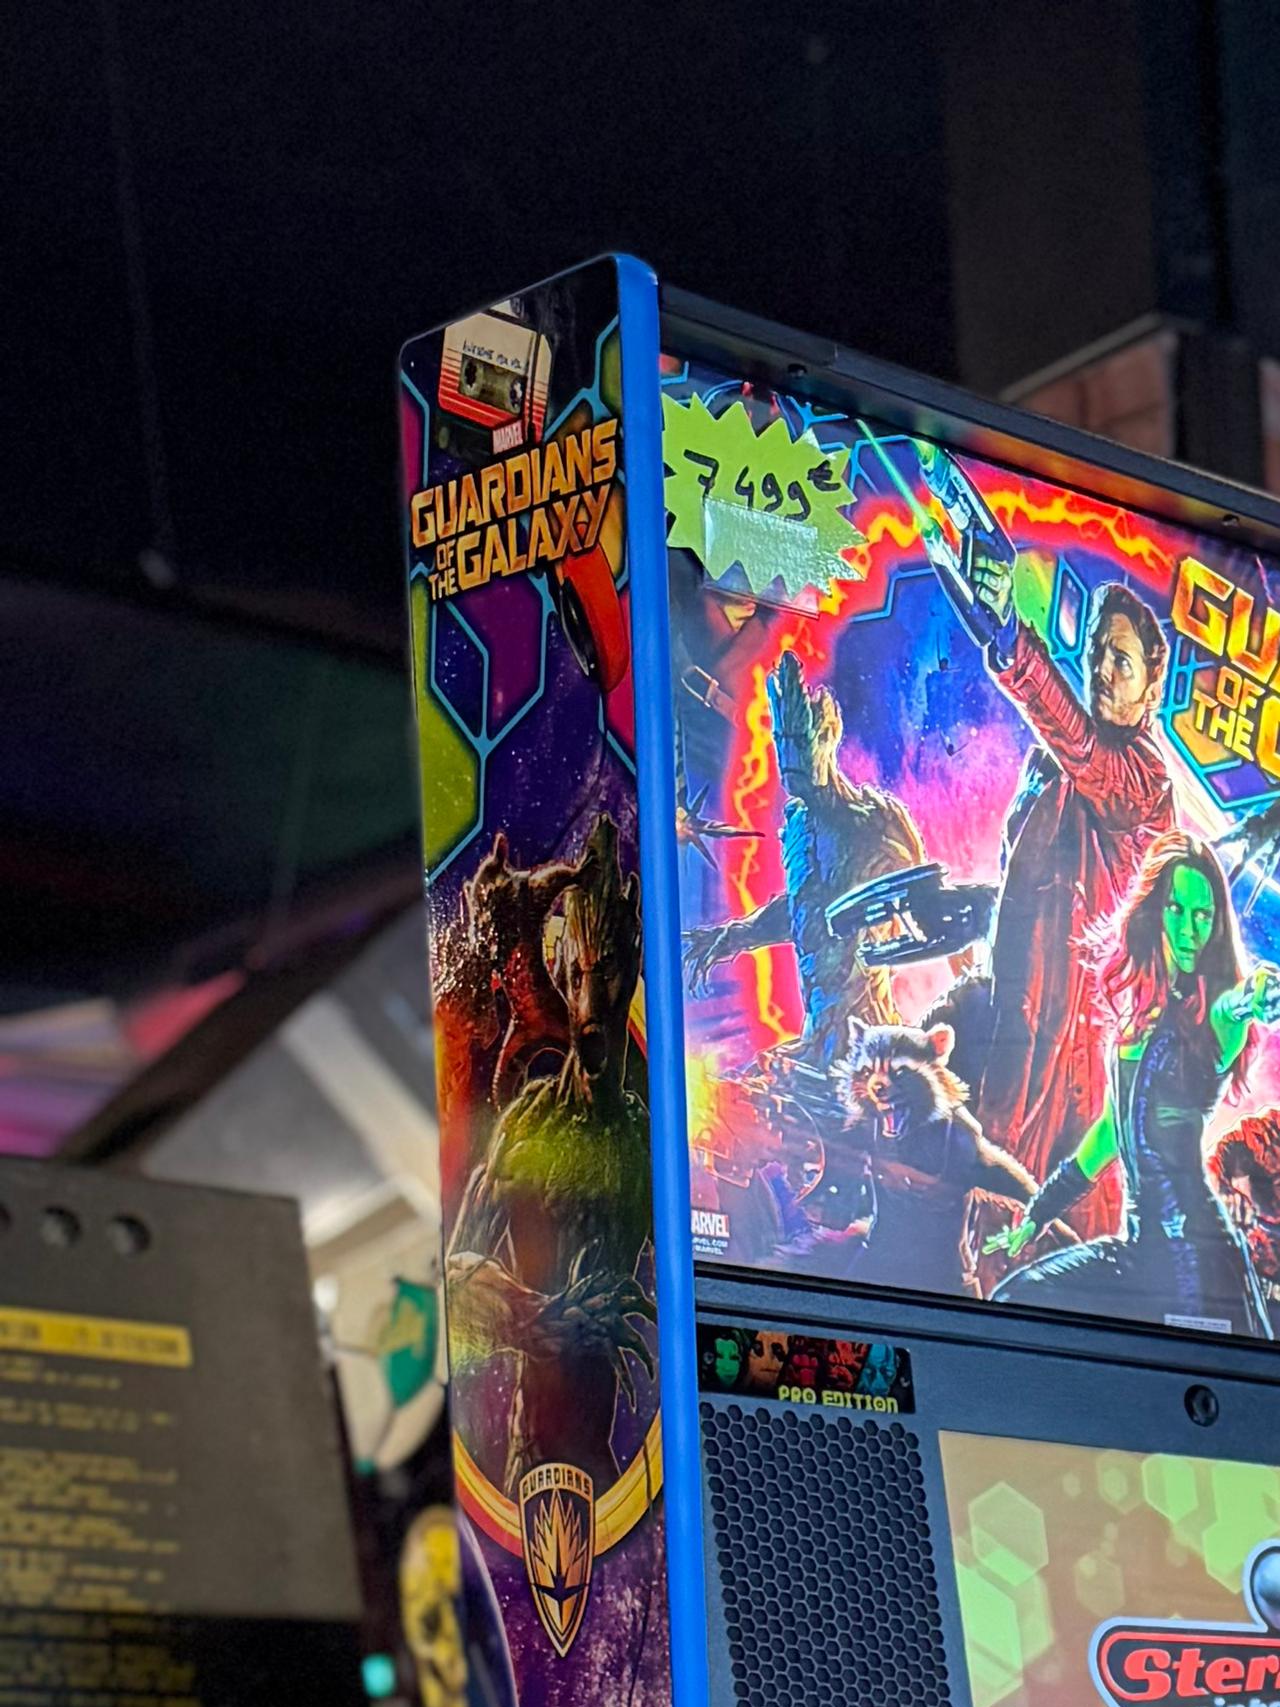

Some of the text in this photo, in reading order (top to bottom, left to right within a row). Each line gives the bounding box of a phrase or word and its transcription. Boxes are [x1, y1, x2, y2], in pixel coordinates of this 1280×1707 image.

[411, 419, 618, 548] GUARDIANS
[428, 484, 611, 600] THE GALAXY
[436, 540, 456, 571] OF
[1216, 666, 1263, 717] OF
[1193, 690, 1256, 762] THE
[691, 1209, 730, 1238] ARVEL
[778, 1384, 899, 1413] PRO EDITION
[522, 1466, 591, 1499] GUARDIANS
